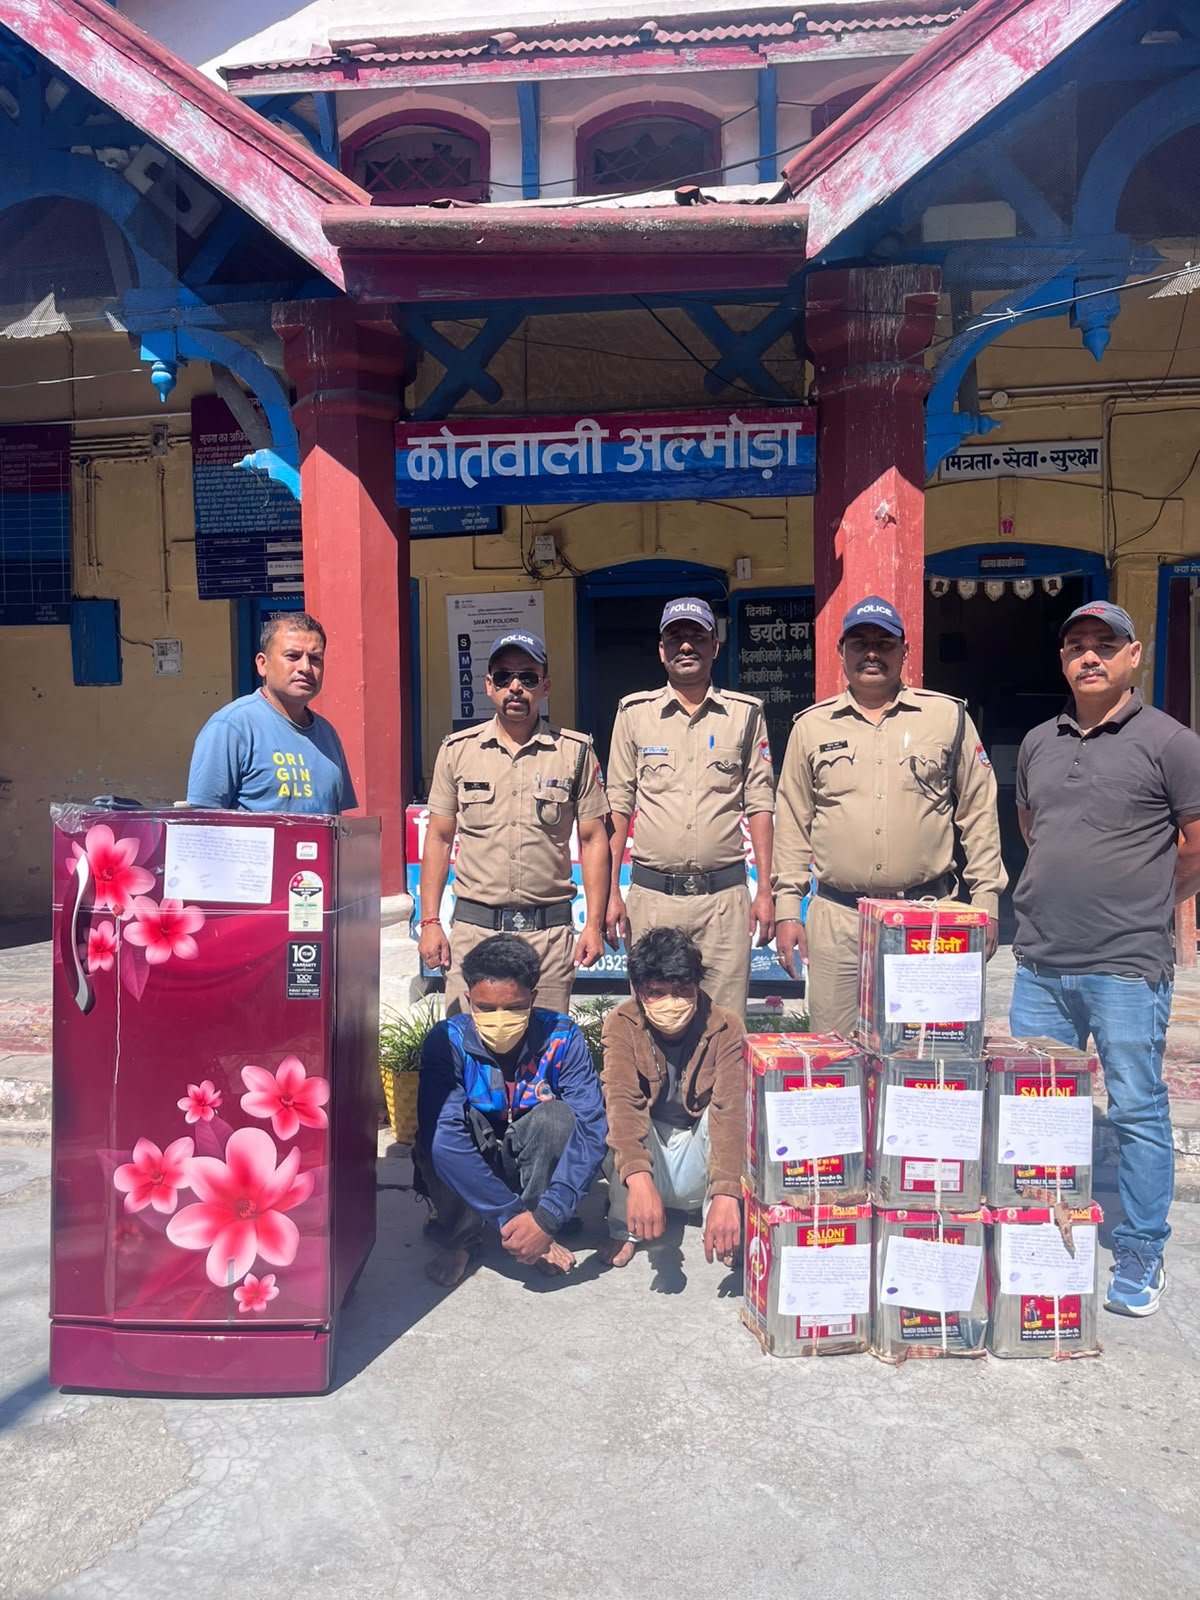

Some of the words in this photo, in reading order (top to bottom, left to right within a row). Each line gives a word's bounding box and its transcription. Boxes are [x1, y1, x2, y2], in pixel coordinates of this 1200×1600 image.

[407, 418, 609, 488] कोतवाली
[616, 414, 802, 480] अल्मोड़ा
[1002, 446, 1039, 469] सेवा
[1049, 448, 1099, 472] सुरक्षा
[669, 603, 703, 615] POLICE
[856, 604, 893, 617] POLICE
[492, 616, 519, 624] POLICING
[789, 622, 810, 640] का
[500, 634, 535, 646] POLICE
[272, 751, 305, 766] ORI
[276, 767, 311, 782] GIN
[278, 782, 313, 798] ALS
[291, 944, 316, 963] 10
[579, 954, 628, 972] 0323
